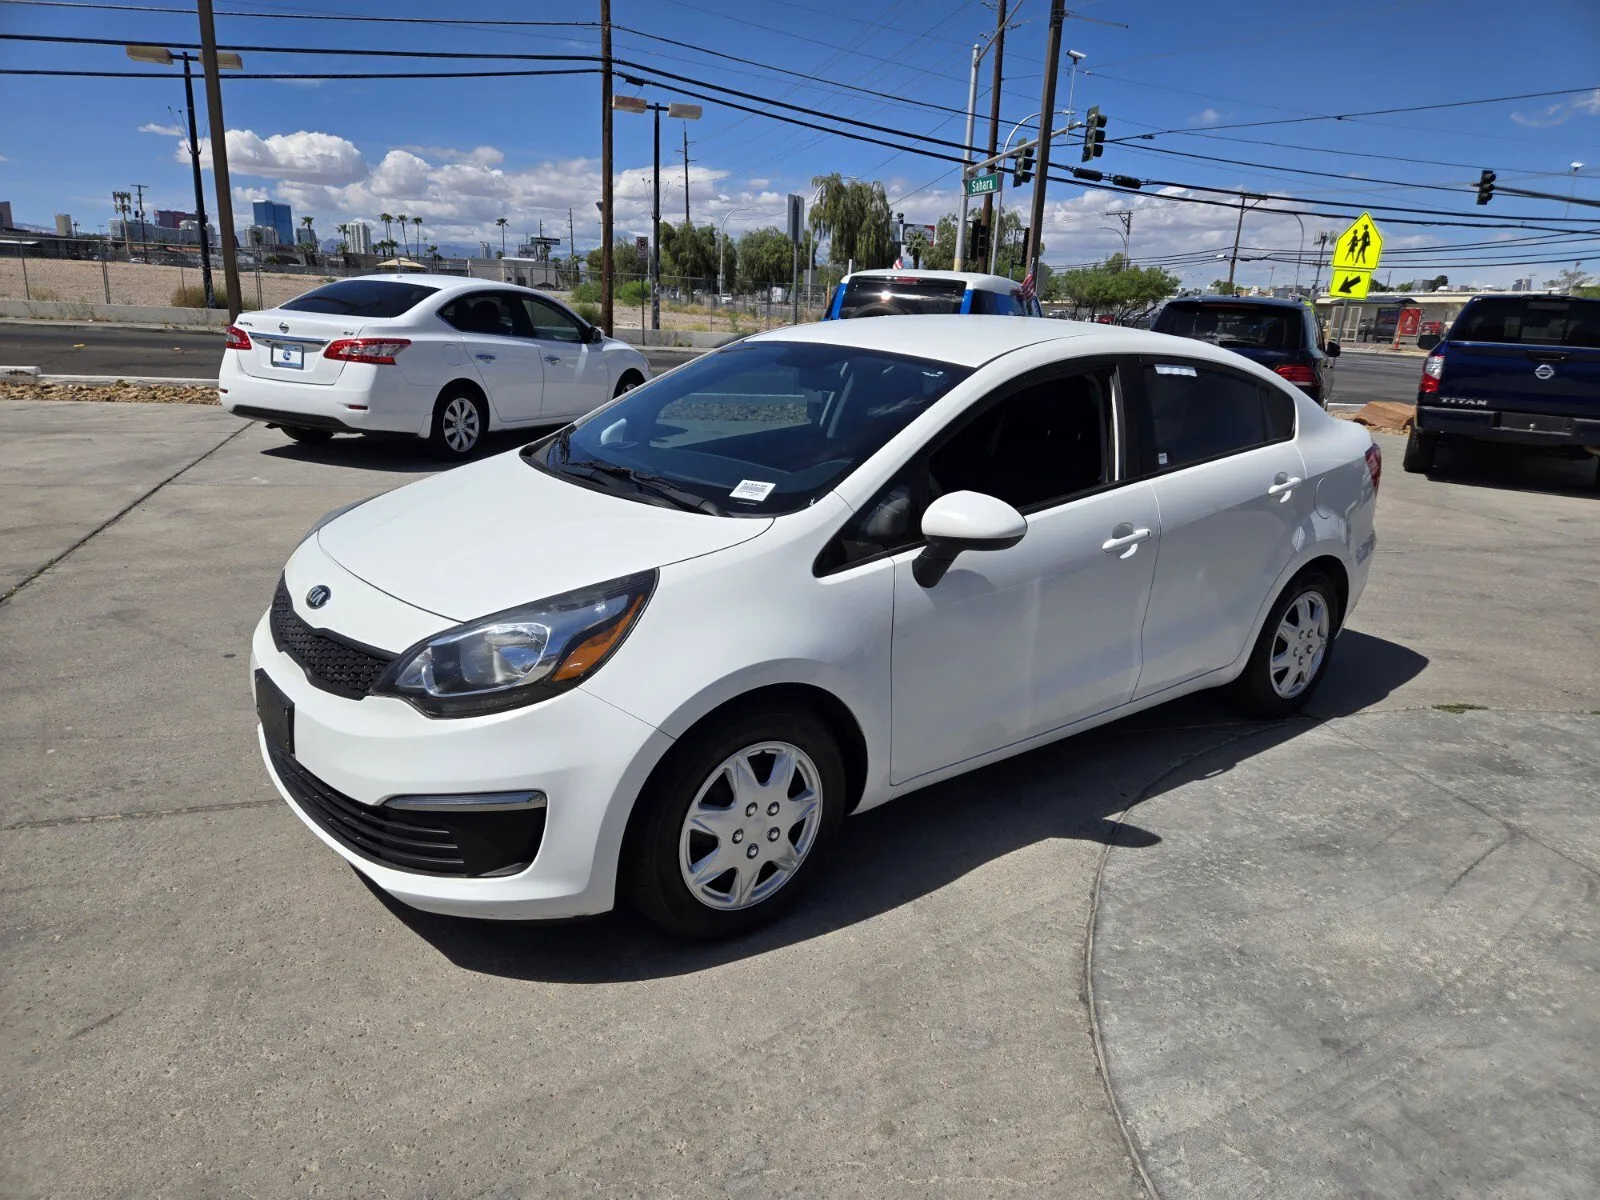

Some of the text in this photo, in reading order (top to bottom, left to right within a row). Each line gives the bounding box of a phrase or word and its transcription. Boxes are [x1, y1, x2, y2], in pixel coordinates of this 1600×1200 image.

[972, 180, 993, 192] Sahara
[1440, 396, 1488, 406] TITAN
[308, 587, 327, 606] KIA
